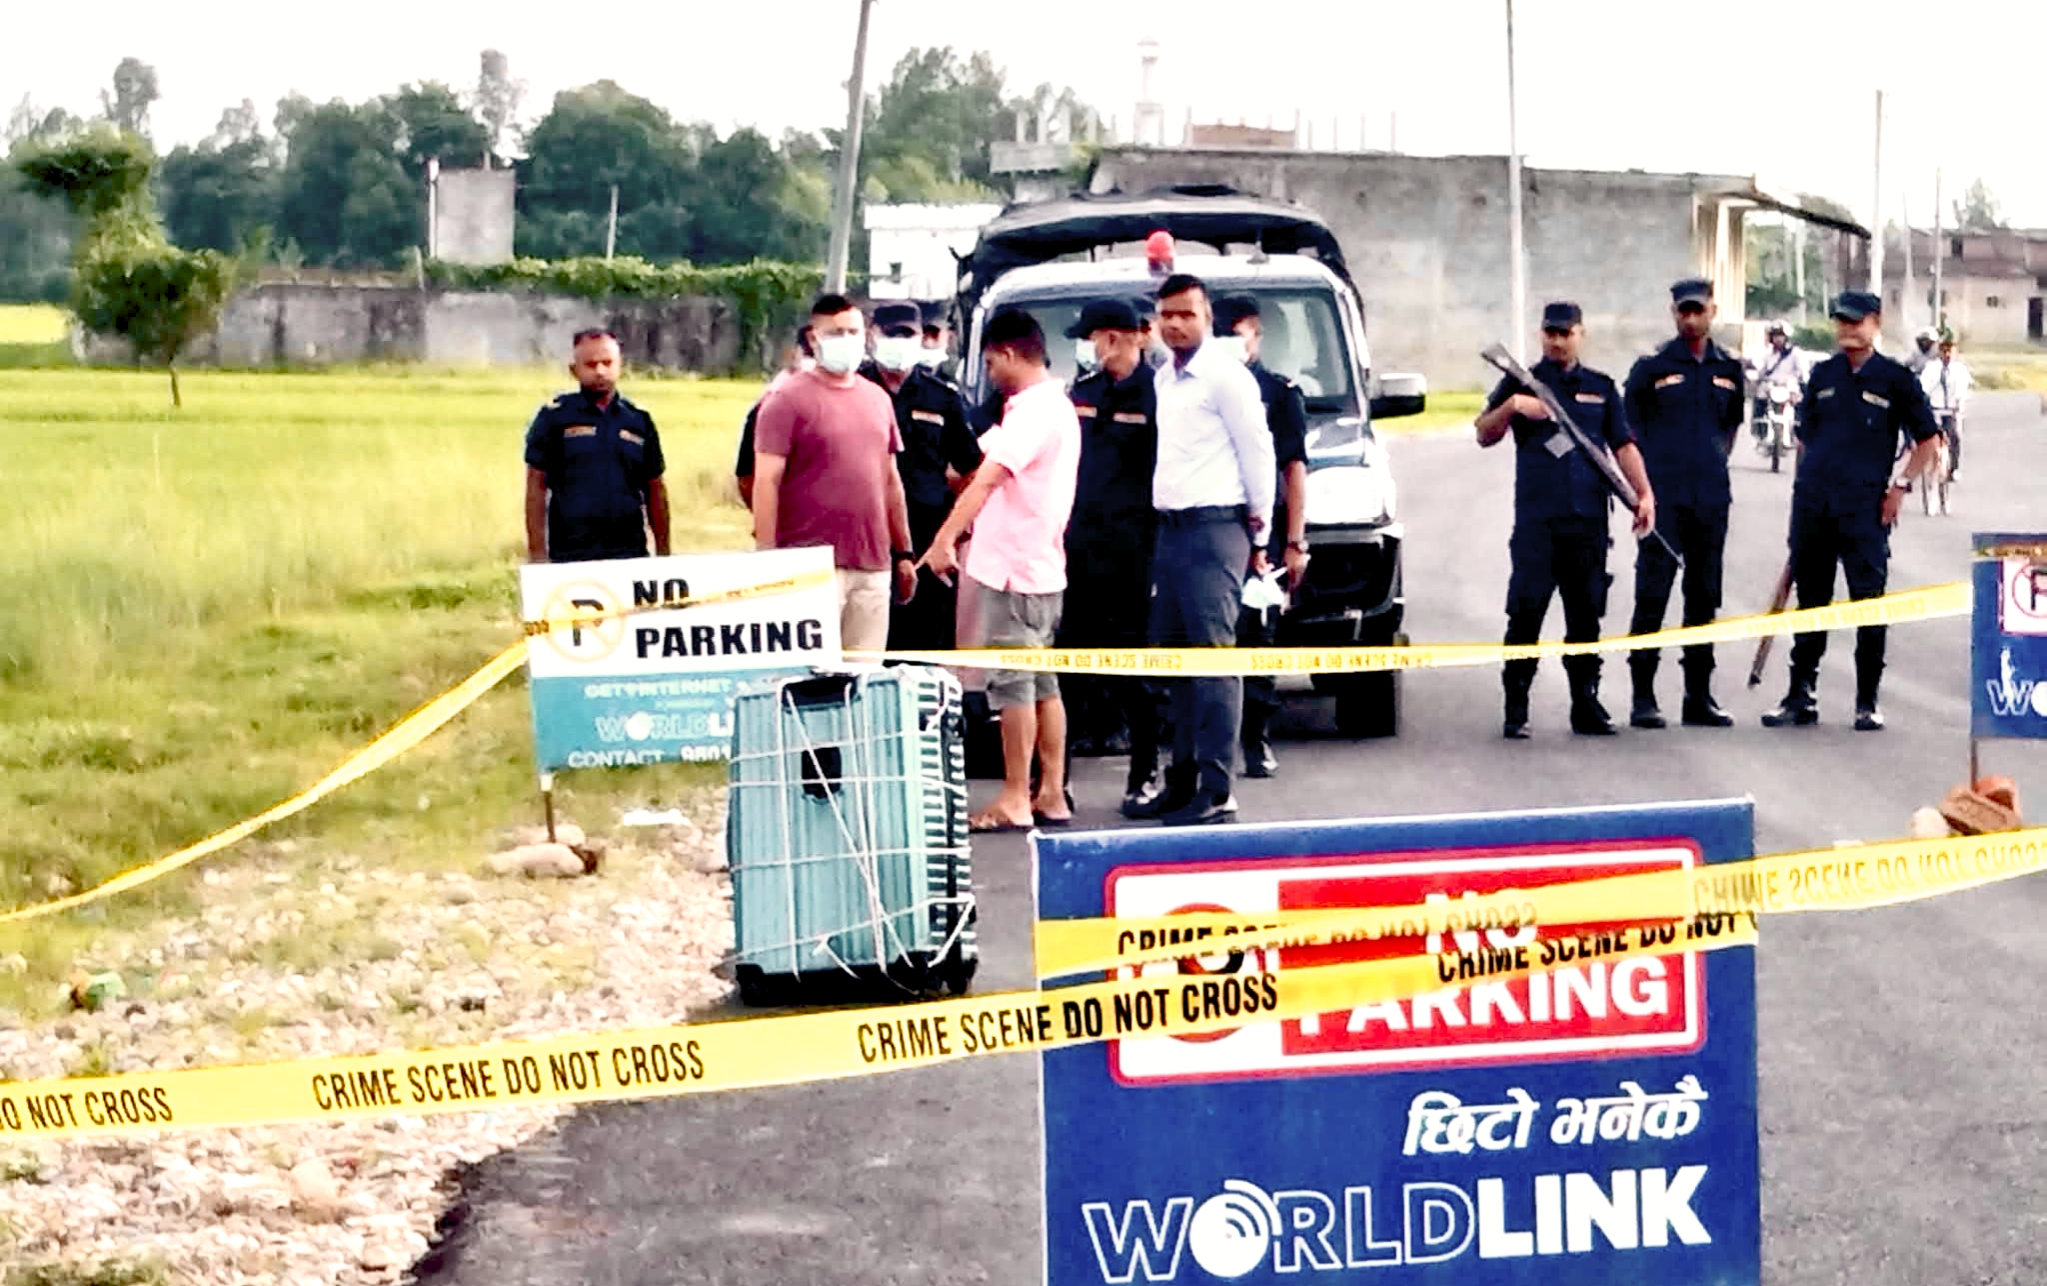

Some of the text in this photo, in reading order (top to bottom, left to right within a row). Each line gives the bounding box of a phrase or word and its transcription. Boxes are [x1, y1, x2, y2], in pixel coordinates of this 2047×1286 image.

[633, 577, 690, 609] NO
[635, 619, 823, 659] PARKING
[568, 749, 665, 768] CONTACT
[1438, 945, 1529, 983] CRIME
[1540, 931, 1629, 965] SCENE
[858, 973, 1278, 1063] CRIME SCENE DO NOT CROSS
[312, 1040, 704, 1111] CRIME SCENE DO NOT CROSS
[26, 1093, 78, 1130] NOT
[85, 1087, 173, 1126] CROSS
[1402, 1087, 1540, 1156] छिटो
[1082, 1165, 1713, 1285] WORLDLINK
